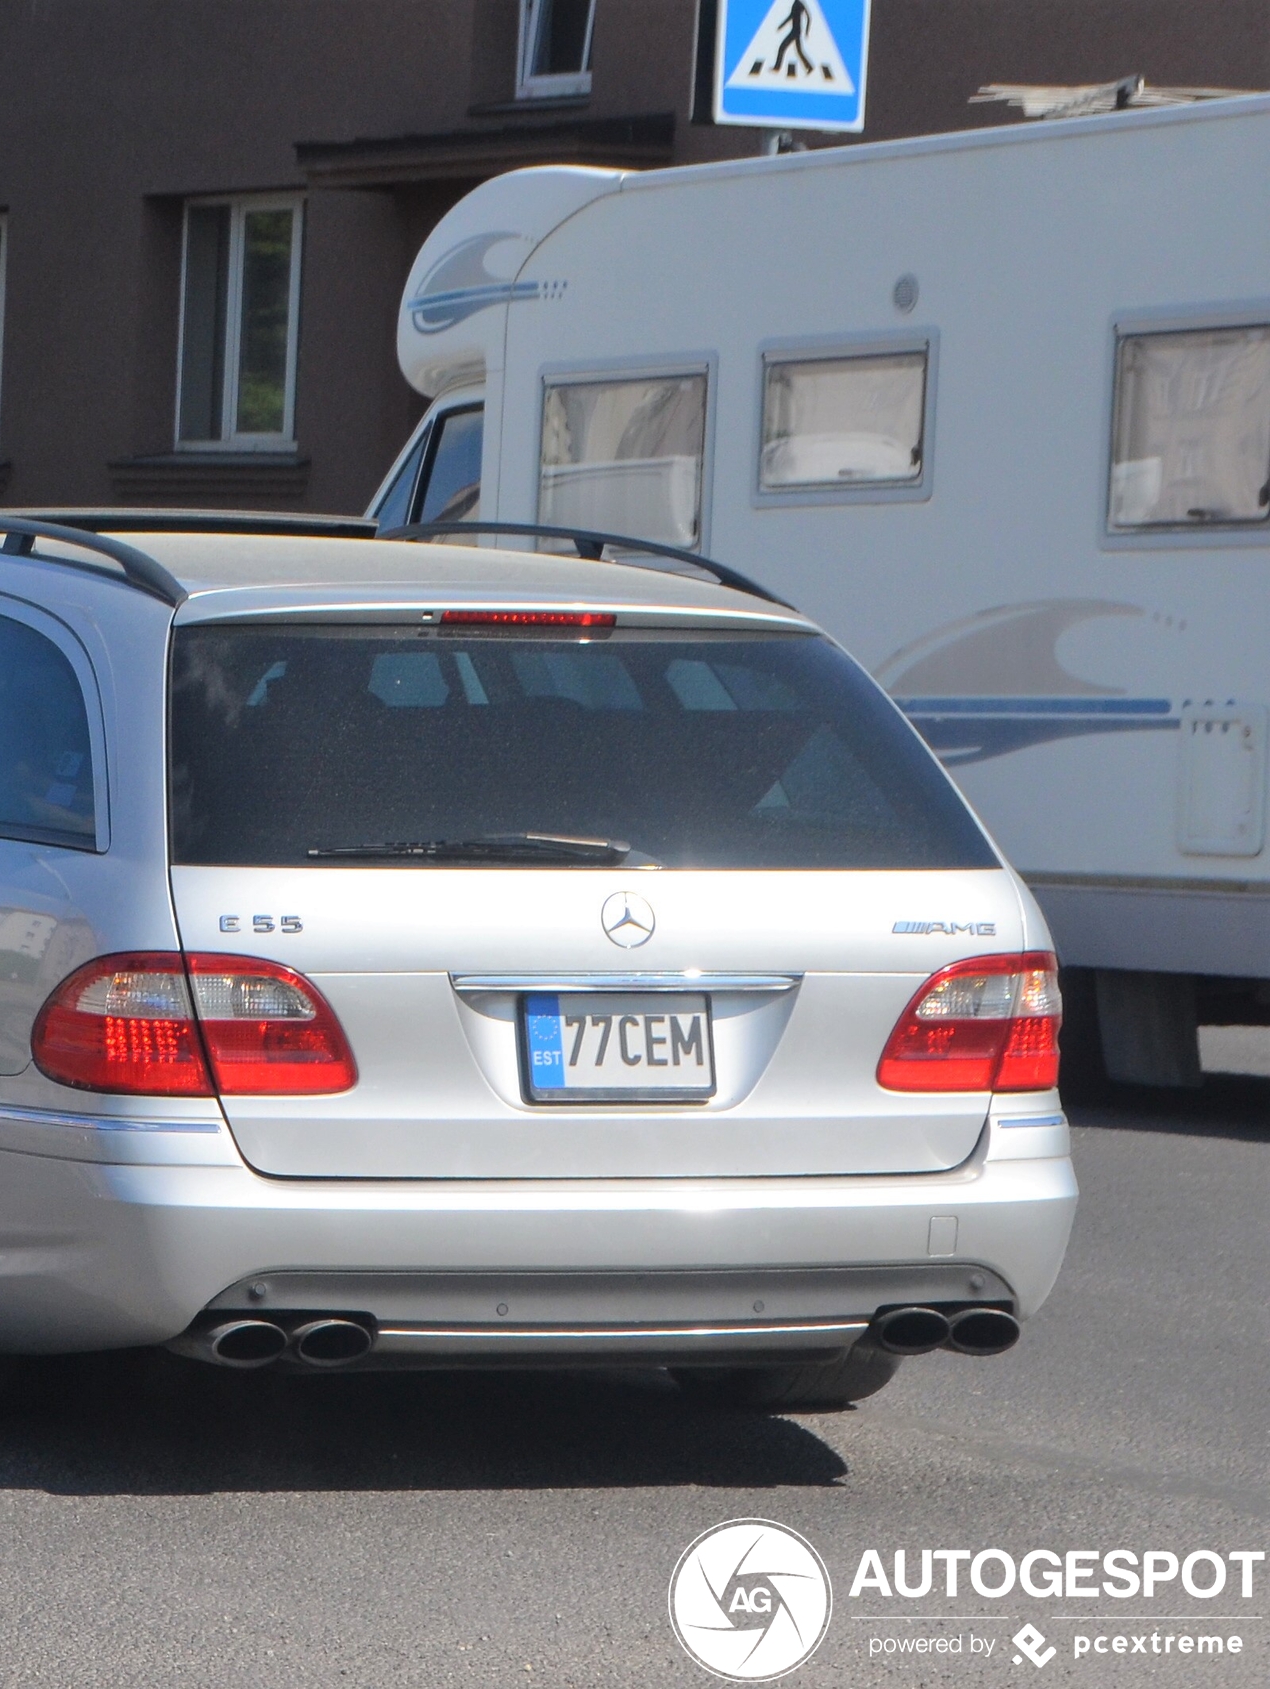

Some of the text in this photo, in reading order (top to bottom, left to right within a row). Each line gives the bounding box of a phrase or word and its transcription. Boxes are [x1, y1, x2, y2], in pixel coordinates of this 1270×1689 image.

[219, 915, 303, 933] E 55
[925, 921, 996, 935] AMG
[565, 1016, 703, 1066] 77CEM
[534, 1051, 561, 1065] EST
